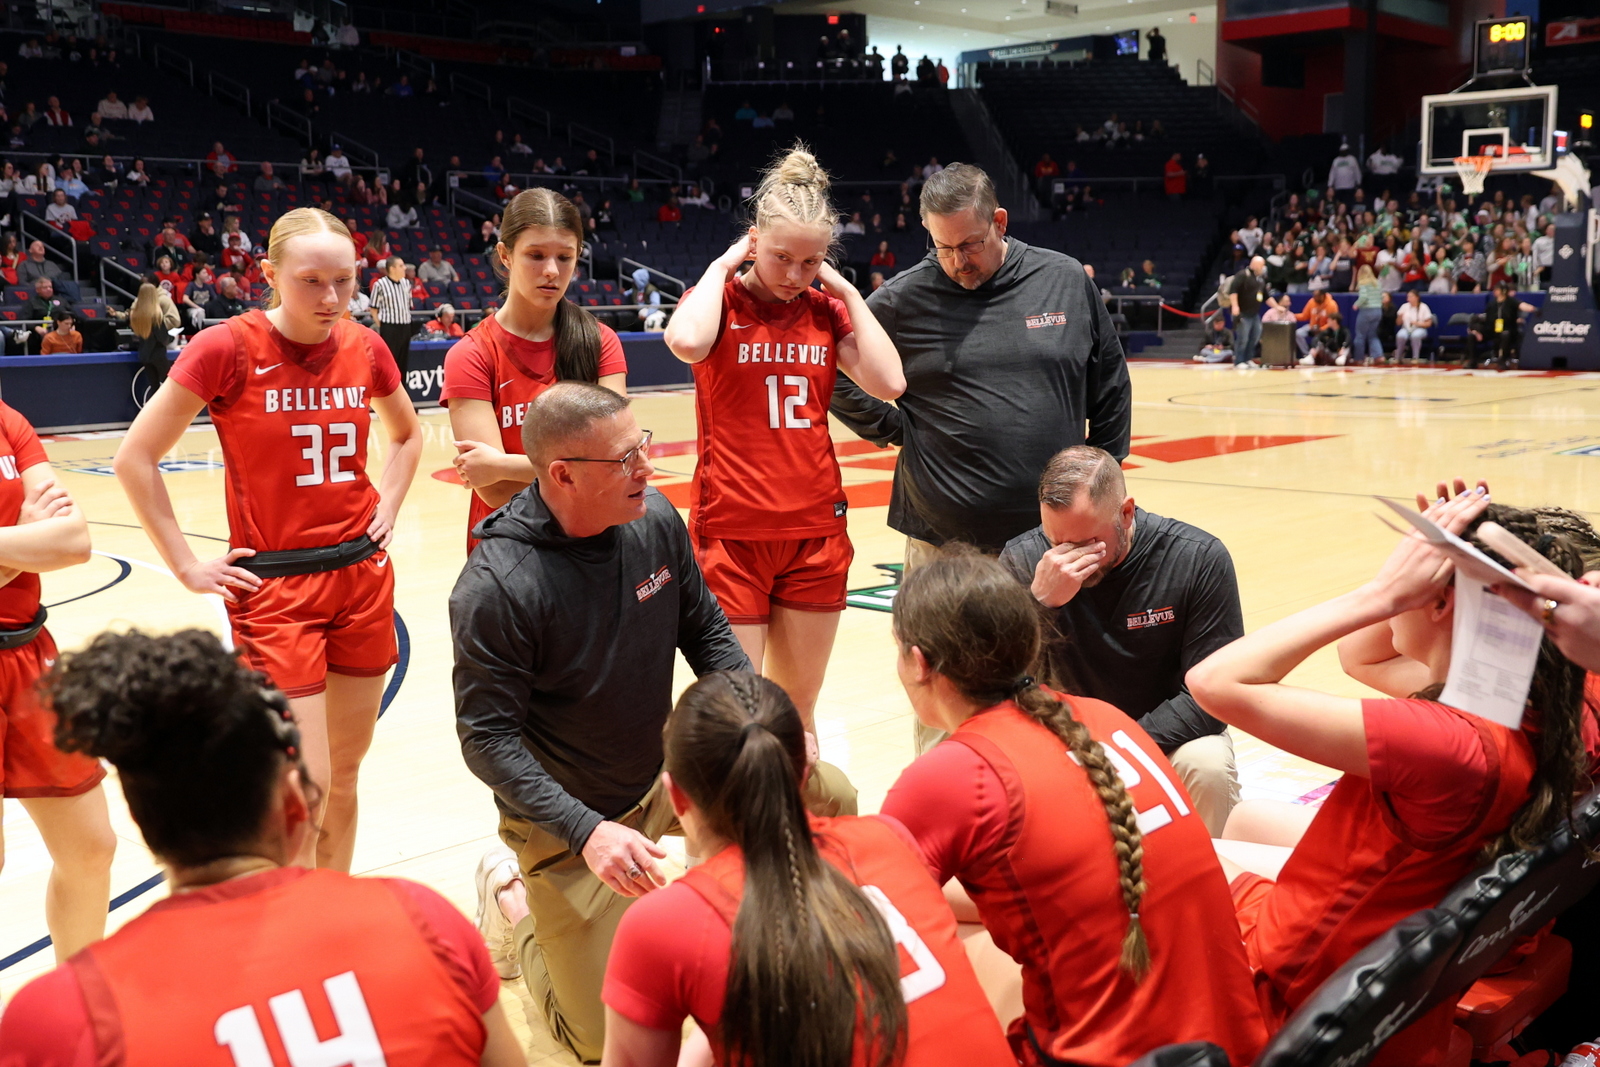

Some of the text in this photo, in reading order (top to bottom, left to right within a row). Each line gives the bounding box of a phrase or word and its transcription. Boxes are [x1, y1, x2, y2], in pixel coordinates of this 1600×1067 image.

[1490, 22, 1526, 43] 8:00
[1548, 285, 1579, 295] Premier
[1550, 294, 1577, 302] Health
[1025, 314, 1067, 328] BELLEVUE
[1533, 320, 1592, 338] altafiber
[737, 342, 828, 367] BELLEVUE
[406, 364, 444, 397] ayt
[265, 385, 367, 413] BELLEVUE
[764, 374, 812, 429] 12
[502, 402, 532, 429] BE
[291, 422, 357, 487] 32
[1127, 610, 1175, 628] BELLEVUE
[214, 970, 389, 1067] 14
